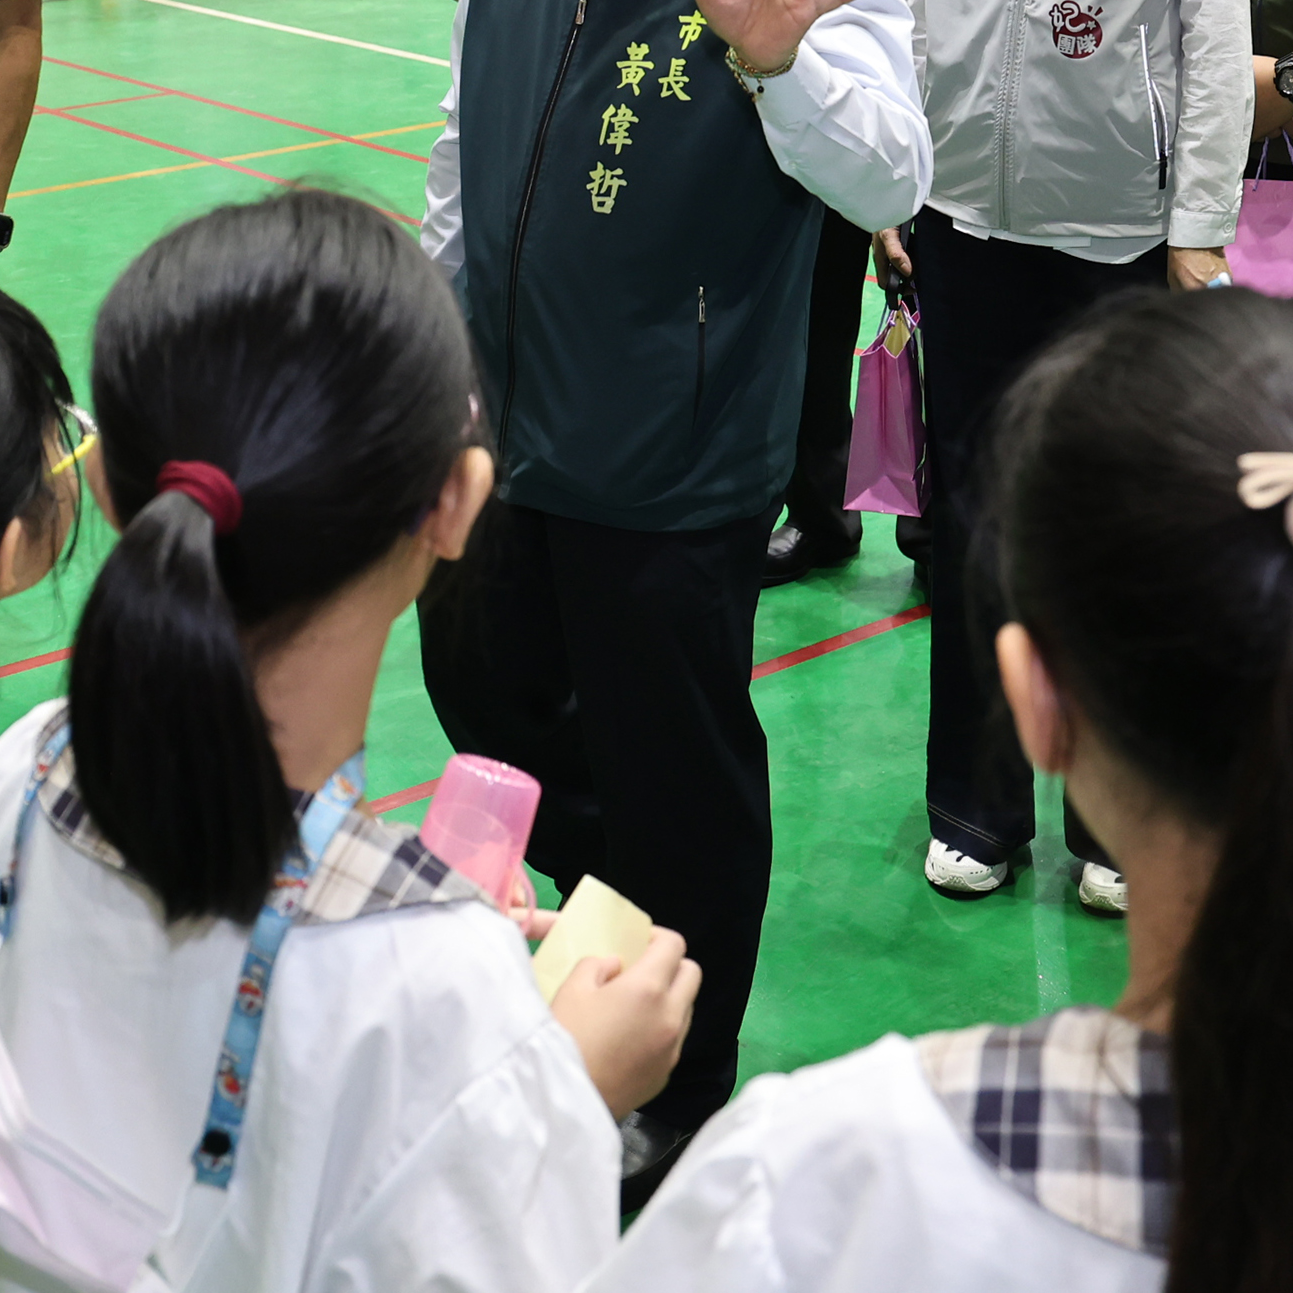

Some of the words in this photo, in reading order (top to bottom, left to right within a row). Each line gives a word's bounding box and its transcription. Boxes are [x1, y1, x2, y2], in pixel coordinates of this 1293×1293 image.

[658, 9, 707, 101] 市長
[586, 41, 655, 214] 黃偉哲
